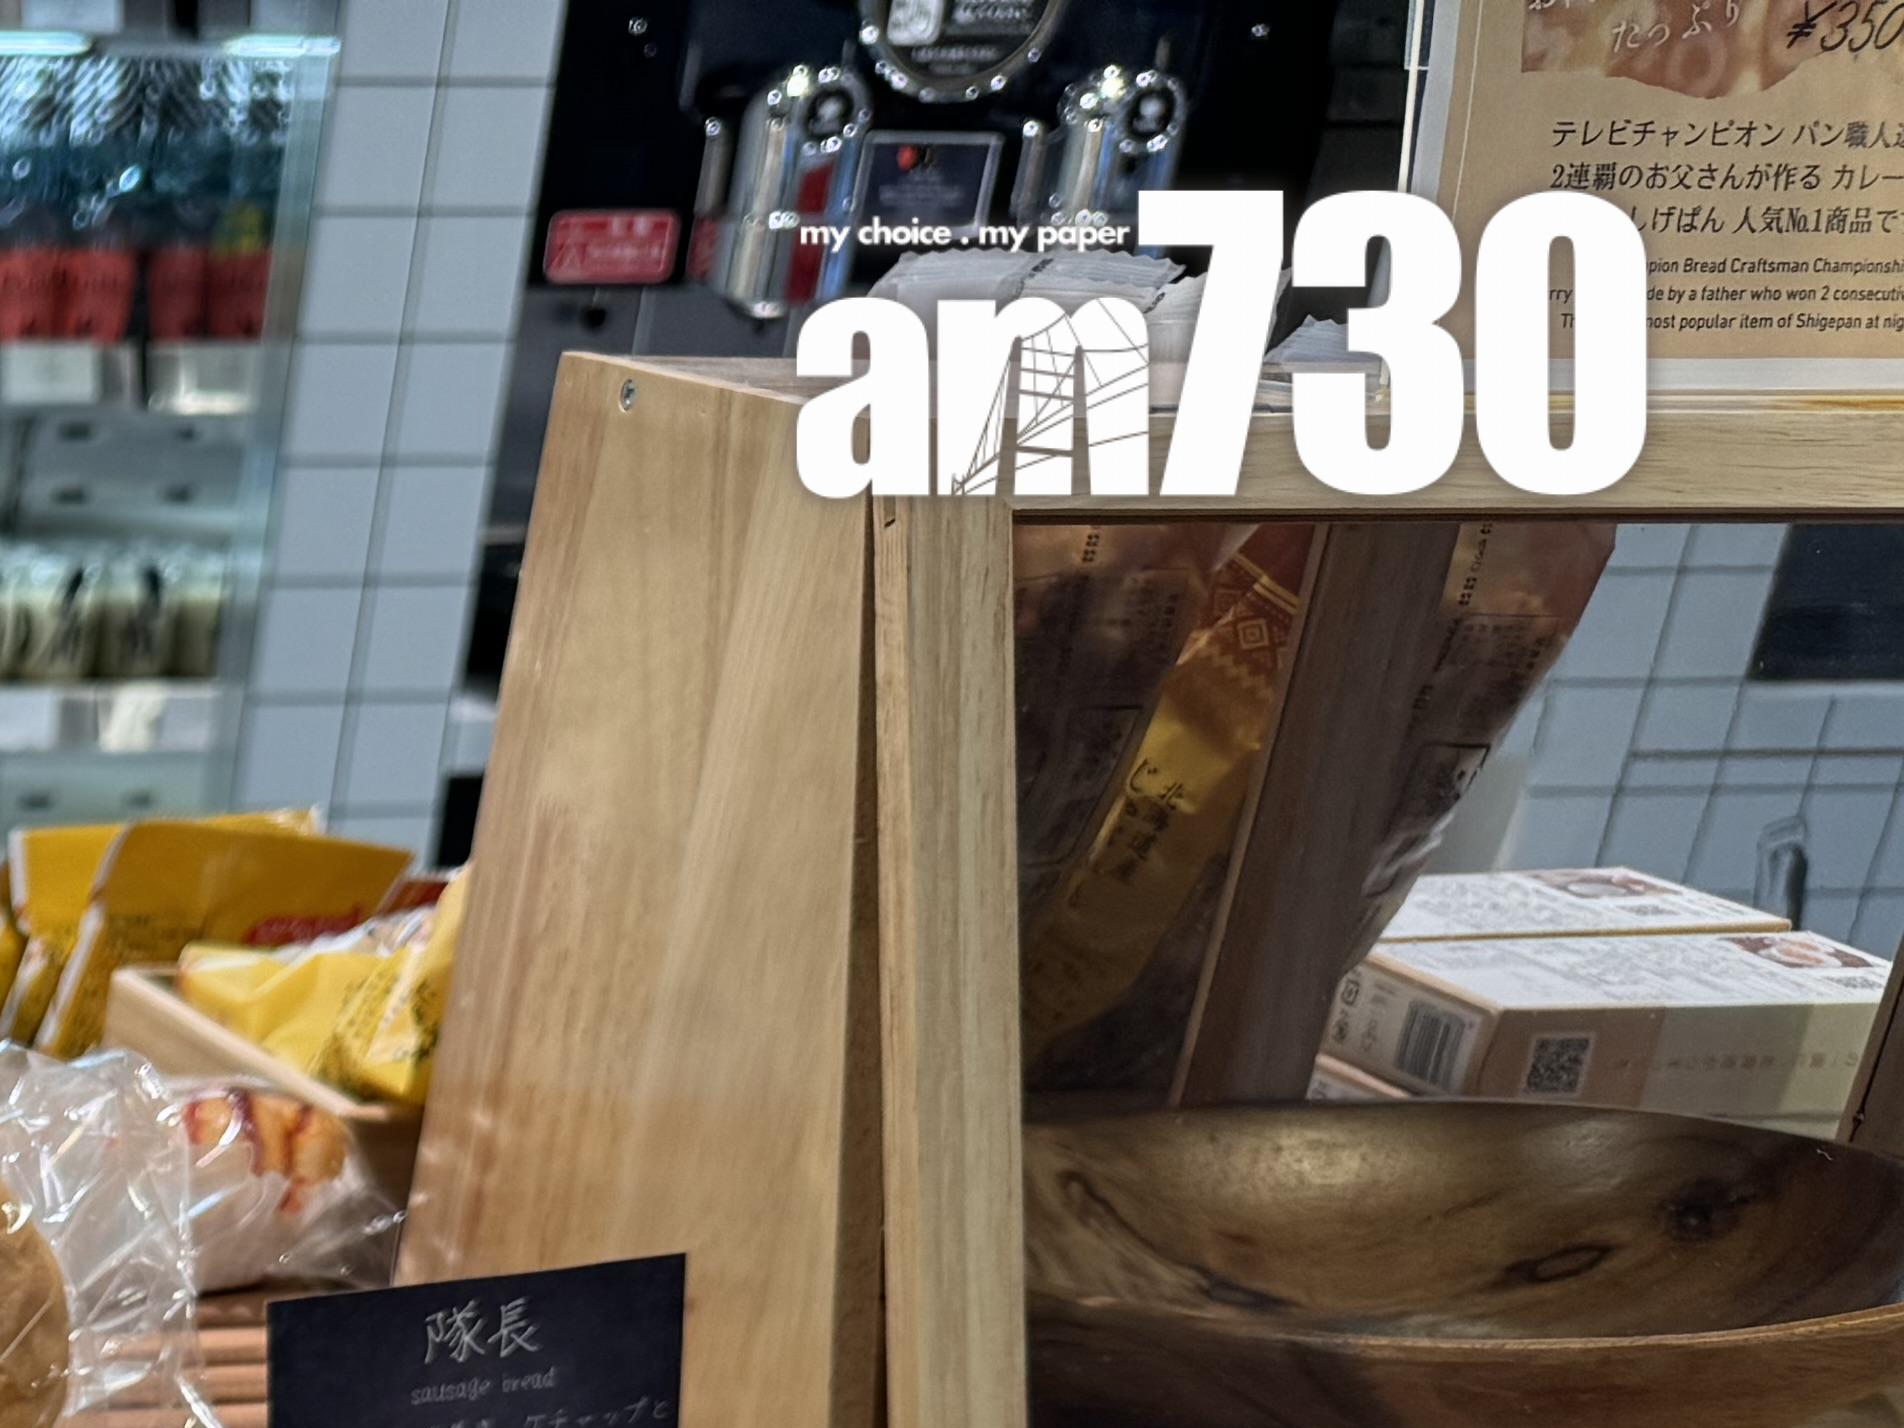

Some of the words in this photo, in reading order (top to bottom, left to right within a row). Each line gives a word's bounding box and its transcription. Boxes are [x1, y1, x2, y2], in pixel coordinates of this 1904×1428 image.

[1552, 119, 1785, 149] テレビチャンピオン
[1550, 162, 1821, 191] 2連覇のお父さんが作る
[1683, 258, 1726, 273] Bread
[1731, 258, 1809, 273] Craftsman
[1668, 288, 1685, 304] by
[1689, 291, 1696, 301] a
[1701, 287, 1745, 301] father
[1751, 286, 1782, 301] who
[1787, 288, 1816, 300] won
[1821, 285, 1830, 300] 2
[1679, 313, 1736, 331] popular
[1739, 313, 1773, 328] item
[1777, 313, 1793, 328] of
[1797, 313, 1861, 332] Shigepan
[1866, 314, 1879, 328] at
[423, 1297, 543, 1365] 隊長
[411, 1378, 491, 1405] sausage
[502, 1367, 556, 1393] bread
